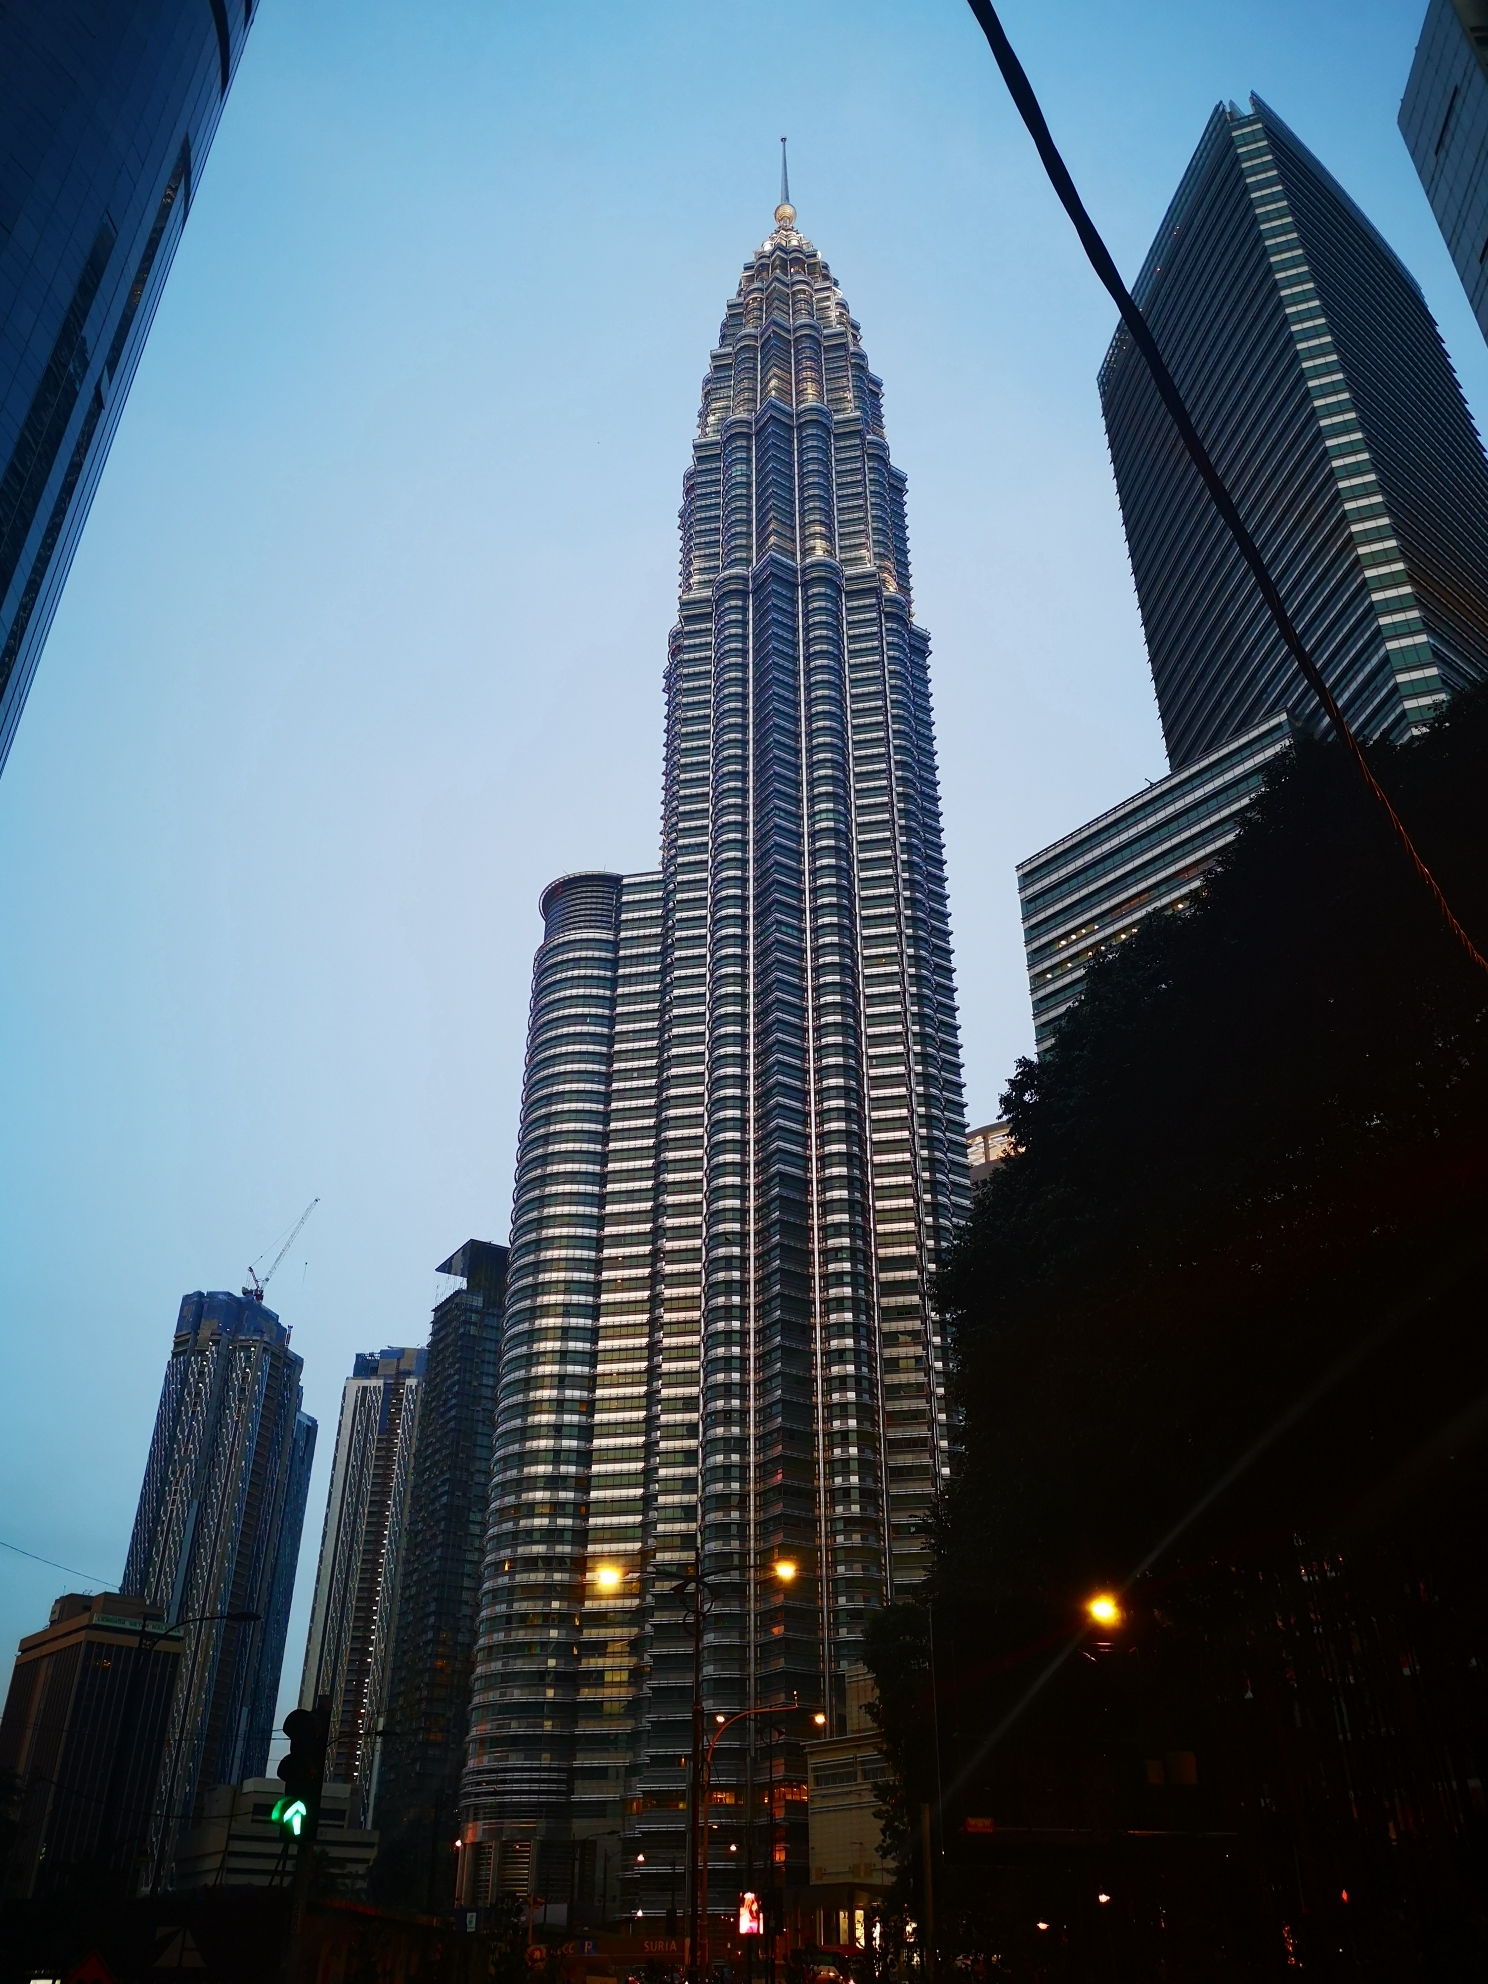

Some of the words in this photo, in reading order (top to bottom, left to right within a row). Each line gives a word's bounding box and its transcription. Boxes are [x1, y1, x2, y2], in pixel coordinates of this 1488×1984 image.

[129, 1620, 150, 1629] GETH
[151, 1624, 181, 1634] MALAIA
[584, 1941, 593, 1953] P
[643, 1940, 677, 1952] SURIA
